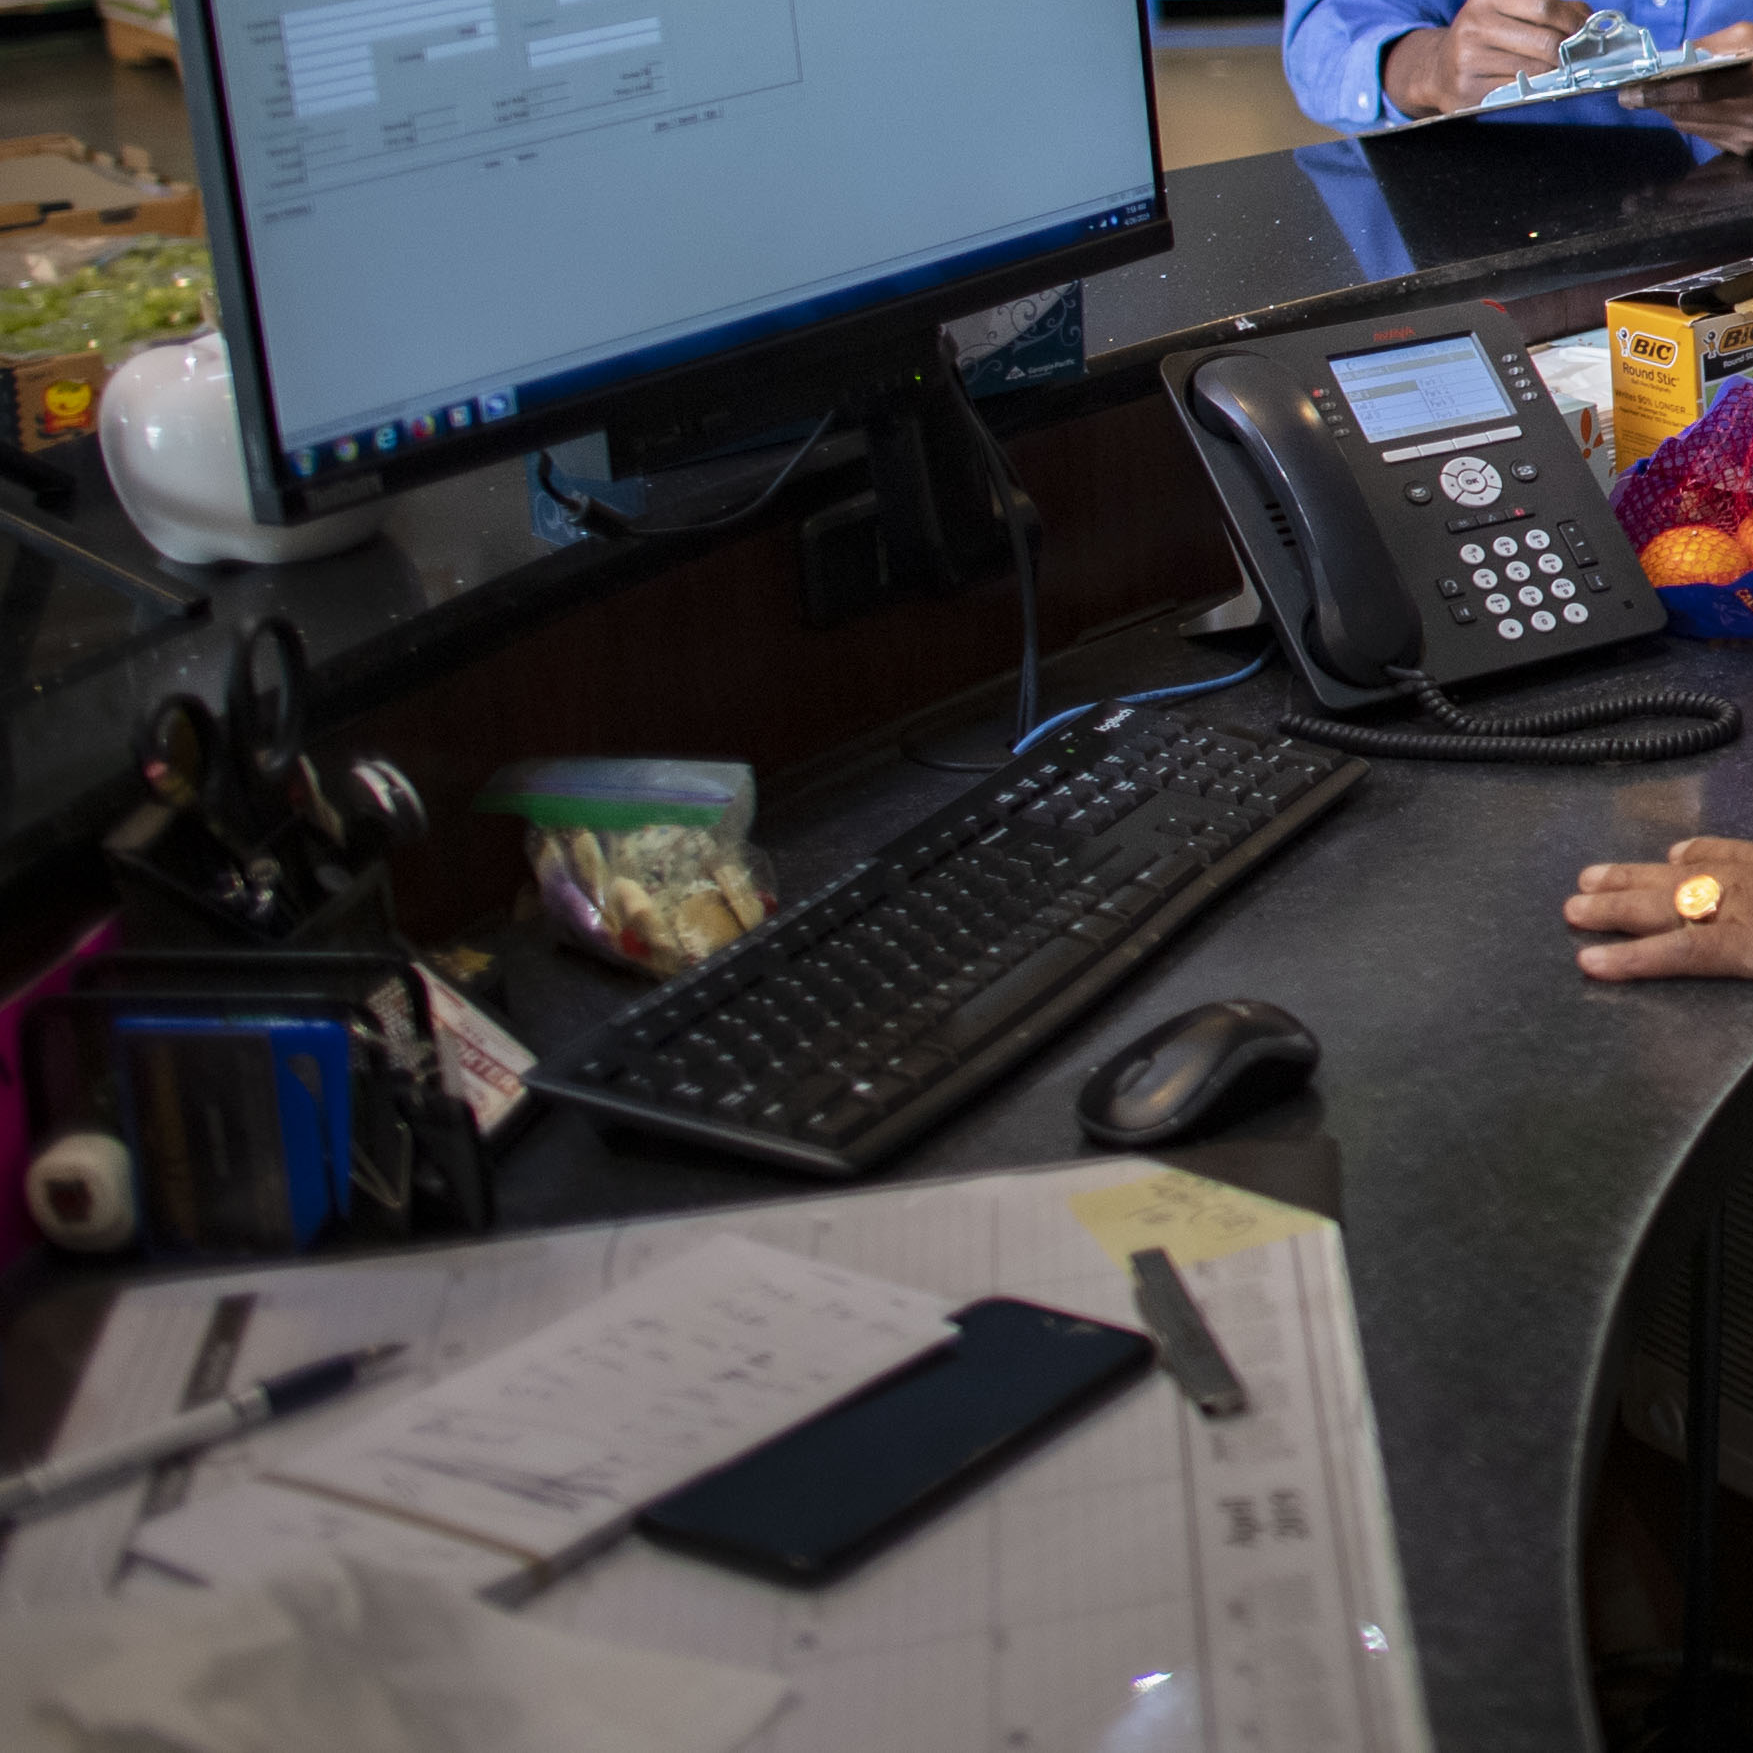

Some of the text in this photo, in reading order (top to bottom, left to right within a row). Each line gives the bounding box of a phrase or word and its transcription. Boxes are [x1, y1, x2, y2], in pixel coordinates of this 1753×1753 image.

[1622, 362, 1678, 387] Round Stic
[1655, 399, 1686, 414] LONGER
[1465, 477, 1480, 486] OK
[1093, 708, 1136, 732] logitech
